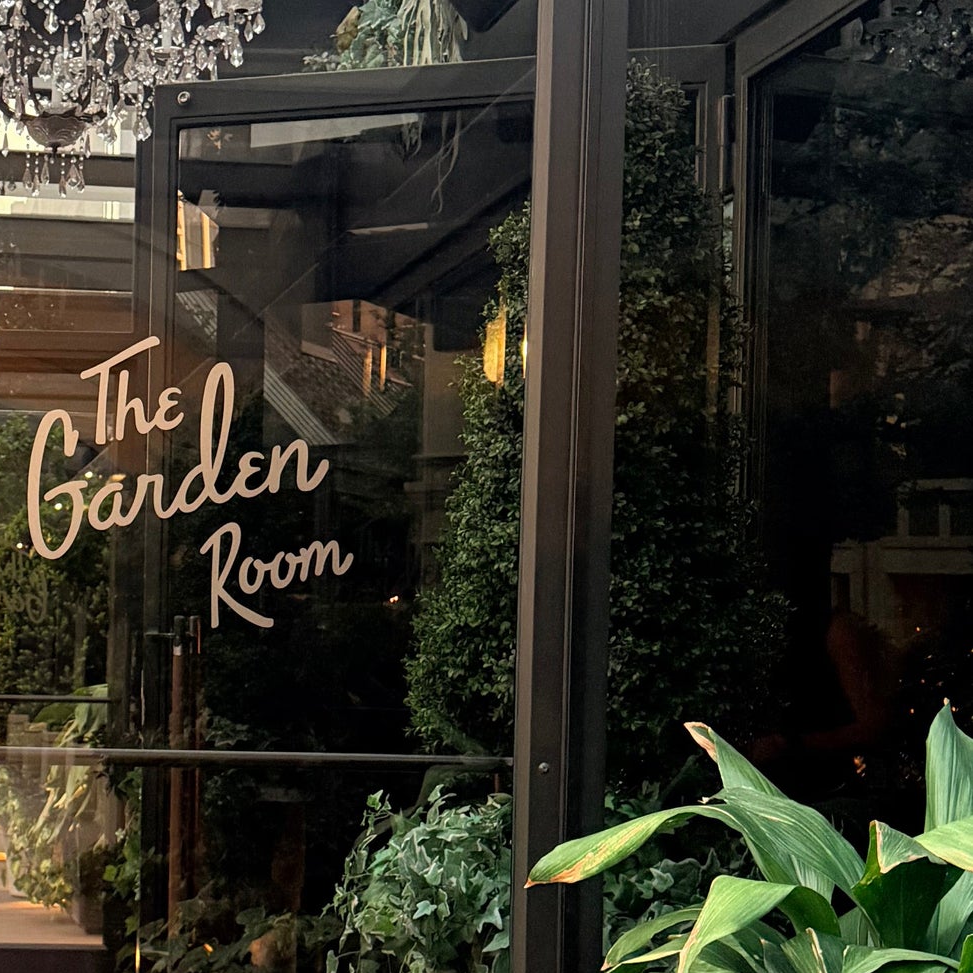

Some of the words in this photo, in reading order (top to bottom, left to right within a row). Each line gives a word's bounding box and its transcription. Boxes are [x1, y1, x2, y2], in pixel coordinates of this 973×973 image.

[80, 336, 184, 445] The
[27, 361, 329, 560] Garden
[199, 522, 354, 628] Room
